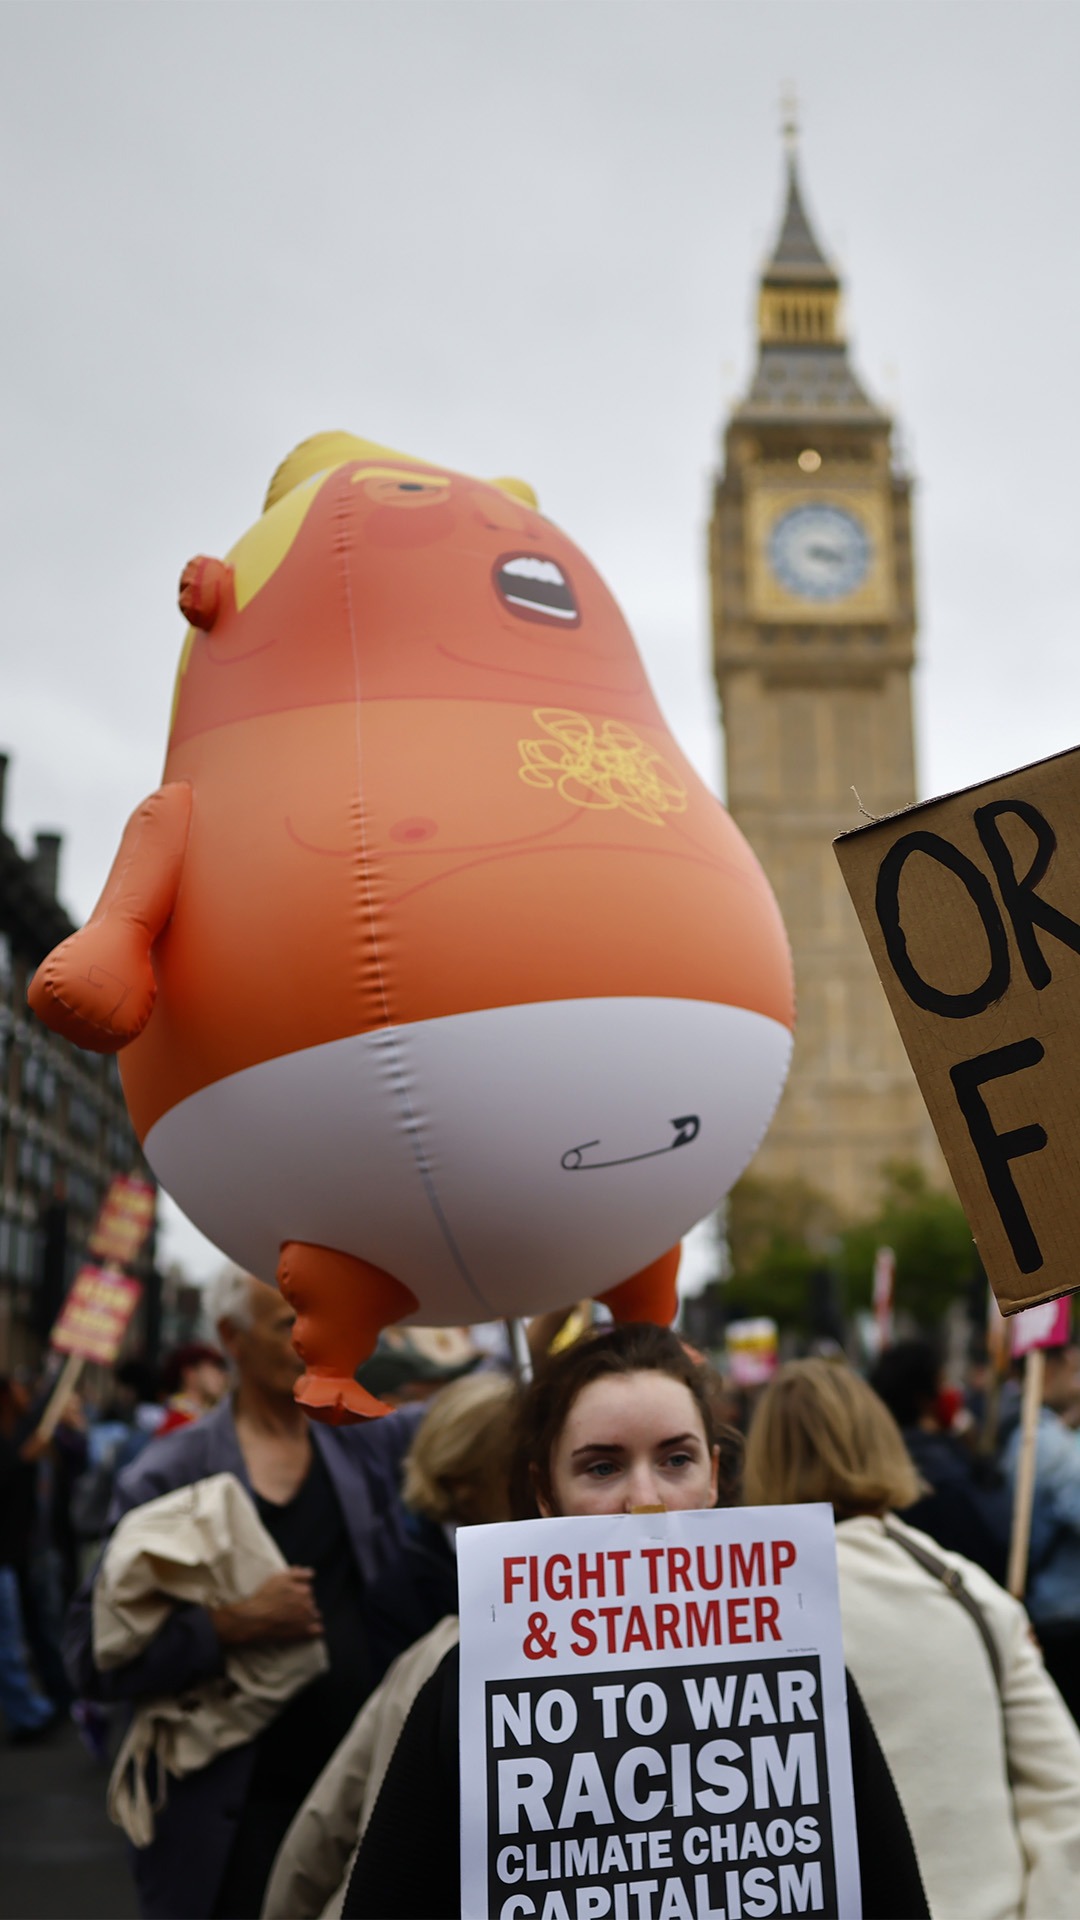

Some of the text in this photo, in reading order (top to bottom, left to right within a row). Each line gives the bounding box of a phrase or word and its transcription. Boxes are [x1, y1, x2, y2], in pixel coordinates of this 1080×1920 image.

[875, 800, 1080, 1019] OR
[502, 1540, 796, 1603] FIGHT TRUMP
[522, 1596, 782, 1660] & STARMER
[491, 1669, 818, 1748] NO TO WAR
[497, 1732, 820, 1835] RACISM
[496, 1816, 821, 1884] CLIMATE CHAOS
